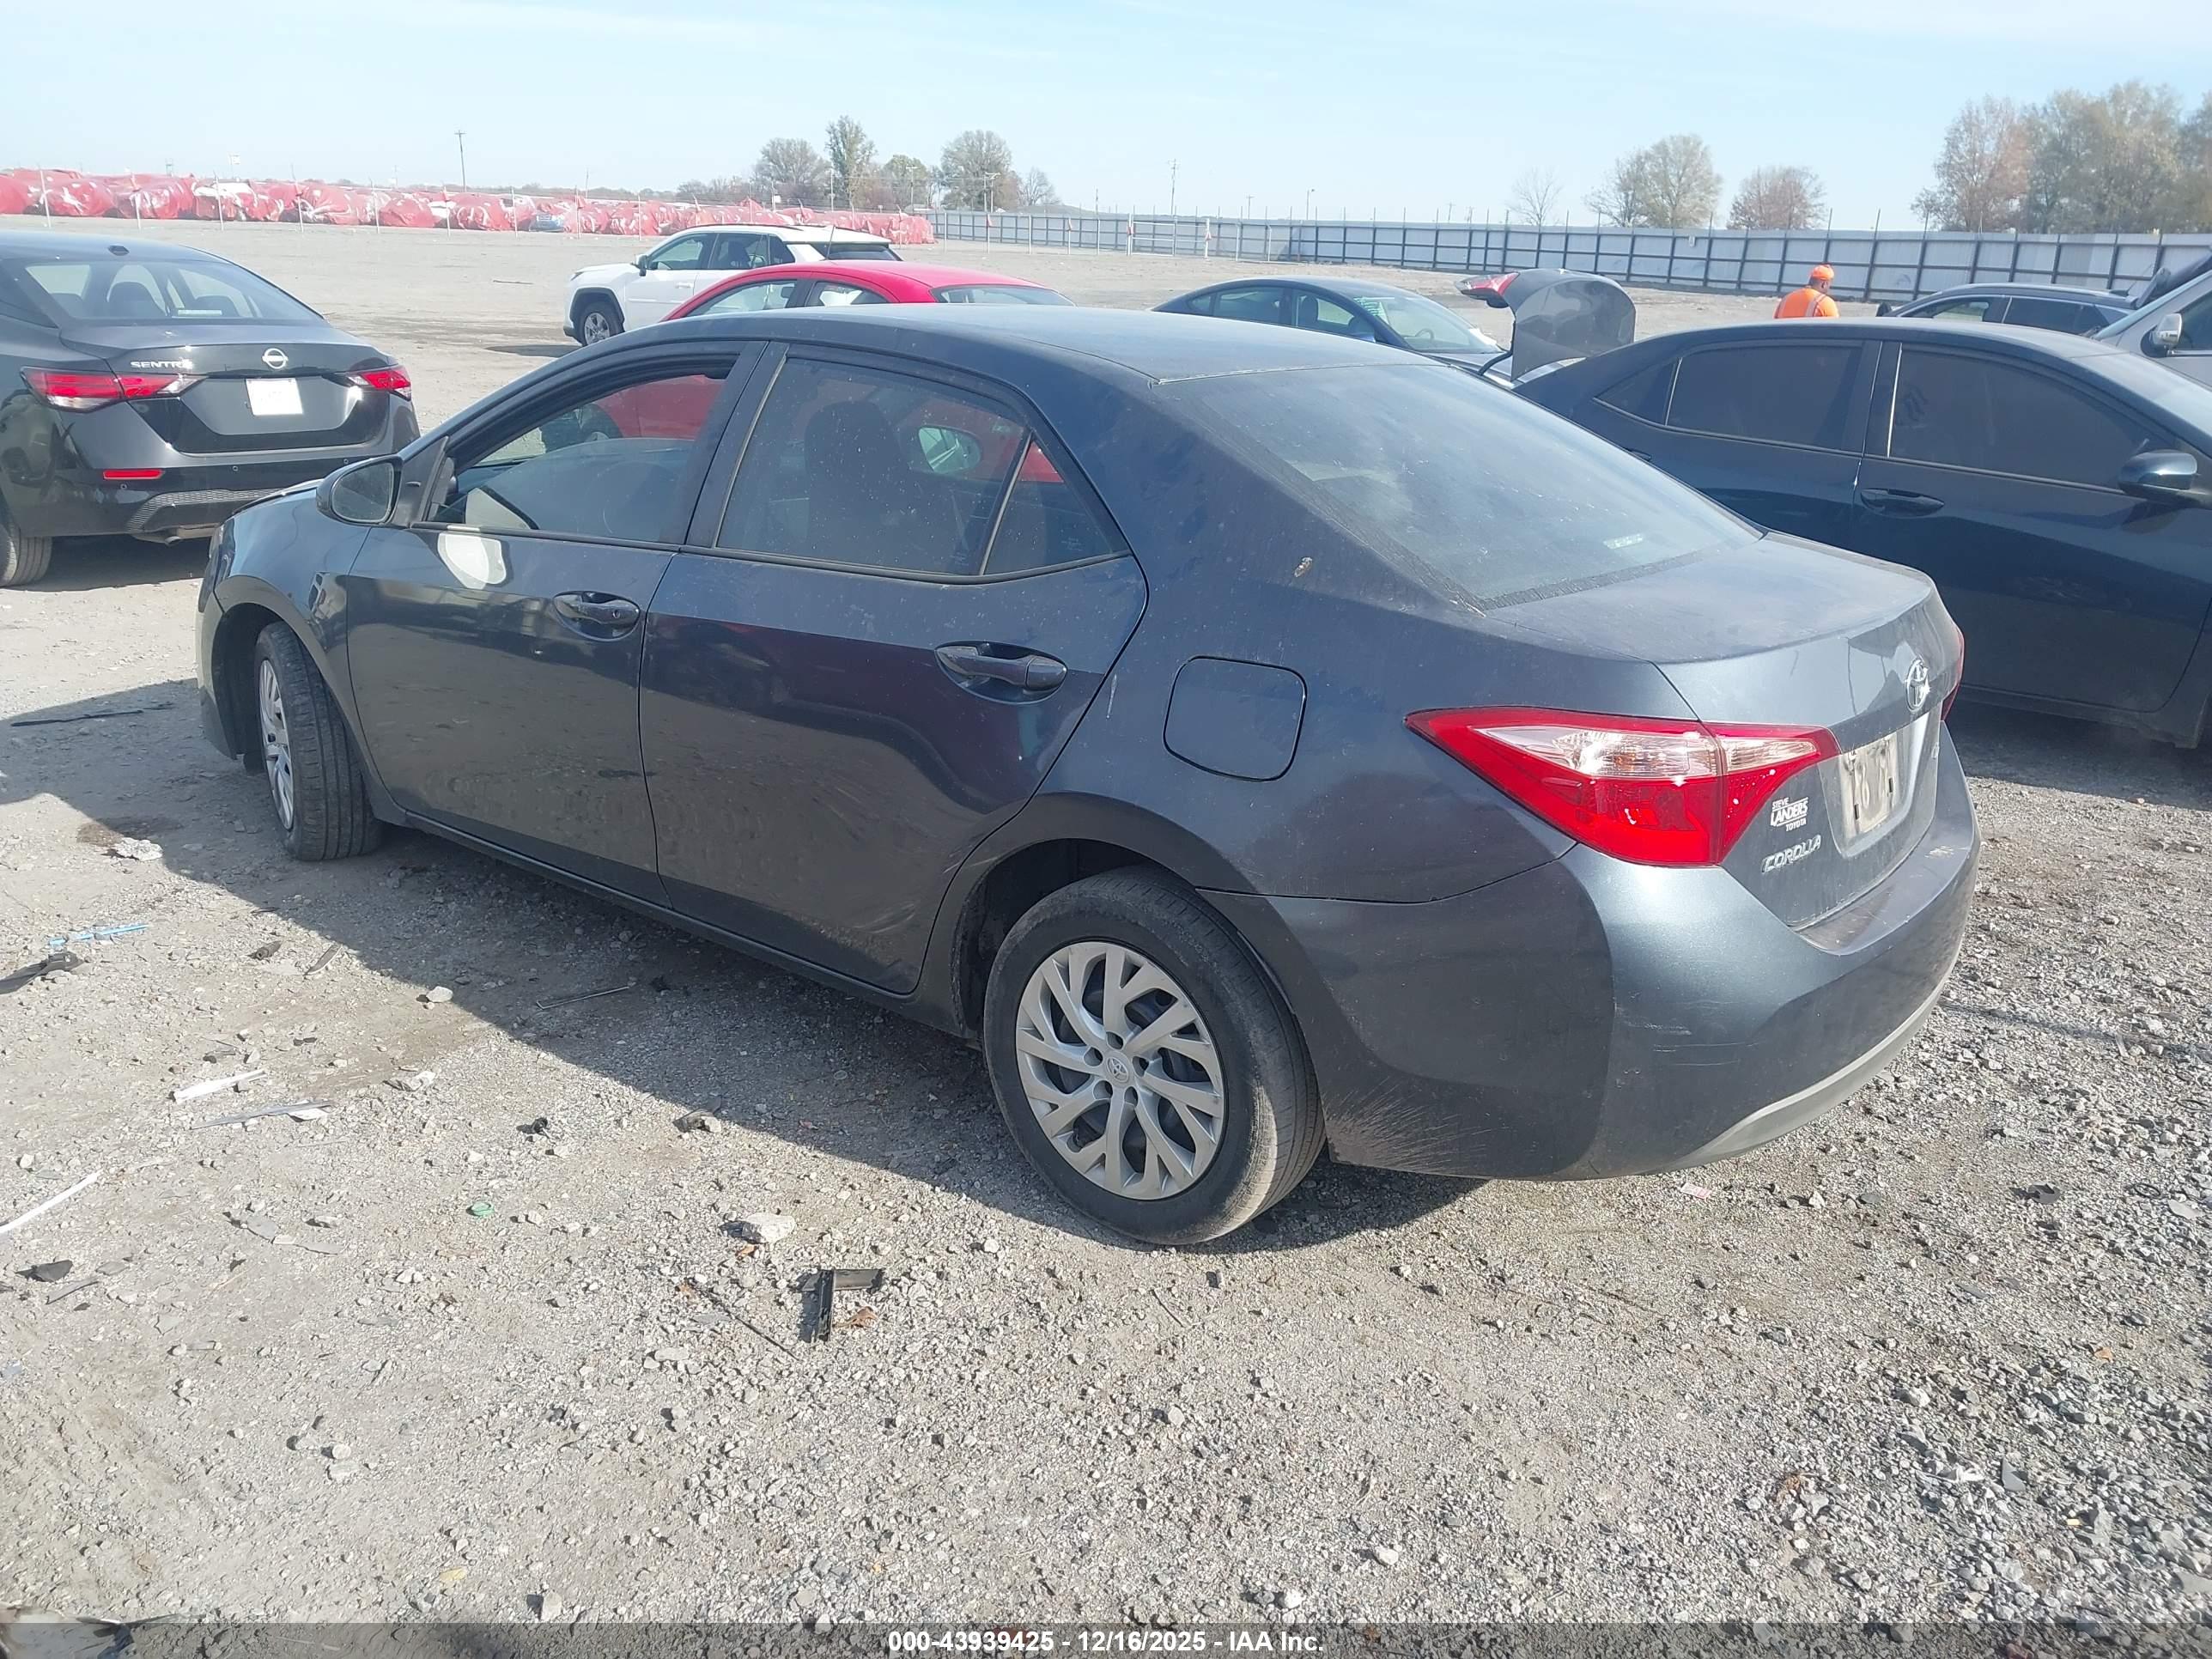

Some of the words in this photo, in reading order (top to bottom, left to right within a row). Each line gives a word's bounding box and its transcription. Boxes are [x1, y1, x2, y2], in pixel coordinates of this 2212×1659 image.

[1771, 800, 1808, 826] LANDERS
[1772, 797, 1789, 809] STEVE
[1786, 817, 1807, 831] TOYOTA
[1763, 835, 1821, 873] COROLLA
